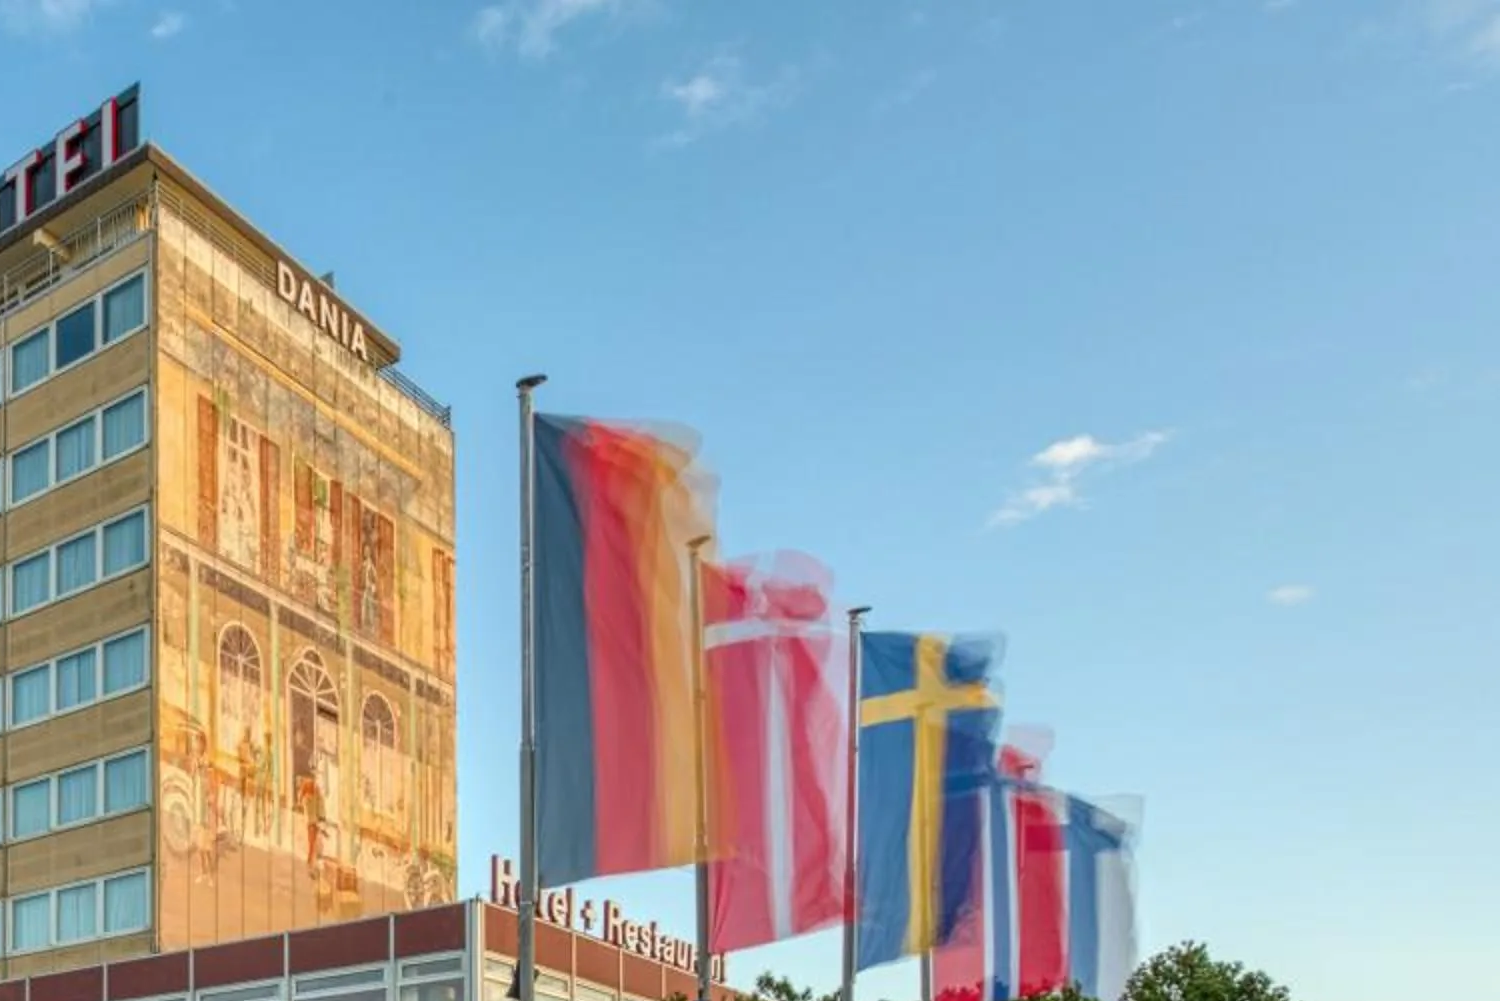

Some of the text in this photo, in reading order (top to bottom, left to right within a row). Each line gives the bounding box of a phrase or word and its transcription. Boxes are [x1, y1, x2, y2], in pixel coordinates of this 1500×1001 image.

[277, 260, 368, 361] DANIA
[491, 855, 576, 930] Htel
[604, 899, 727, 983] Restaurnt
